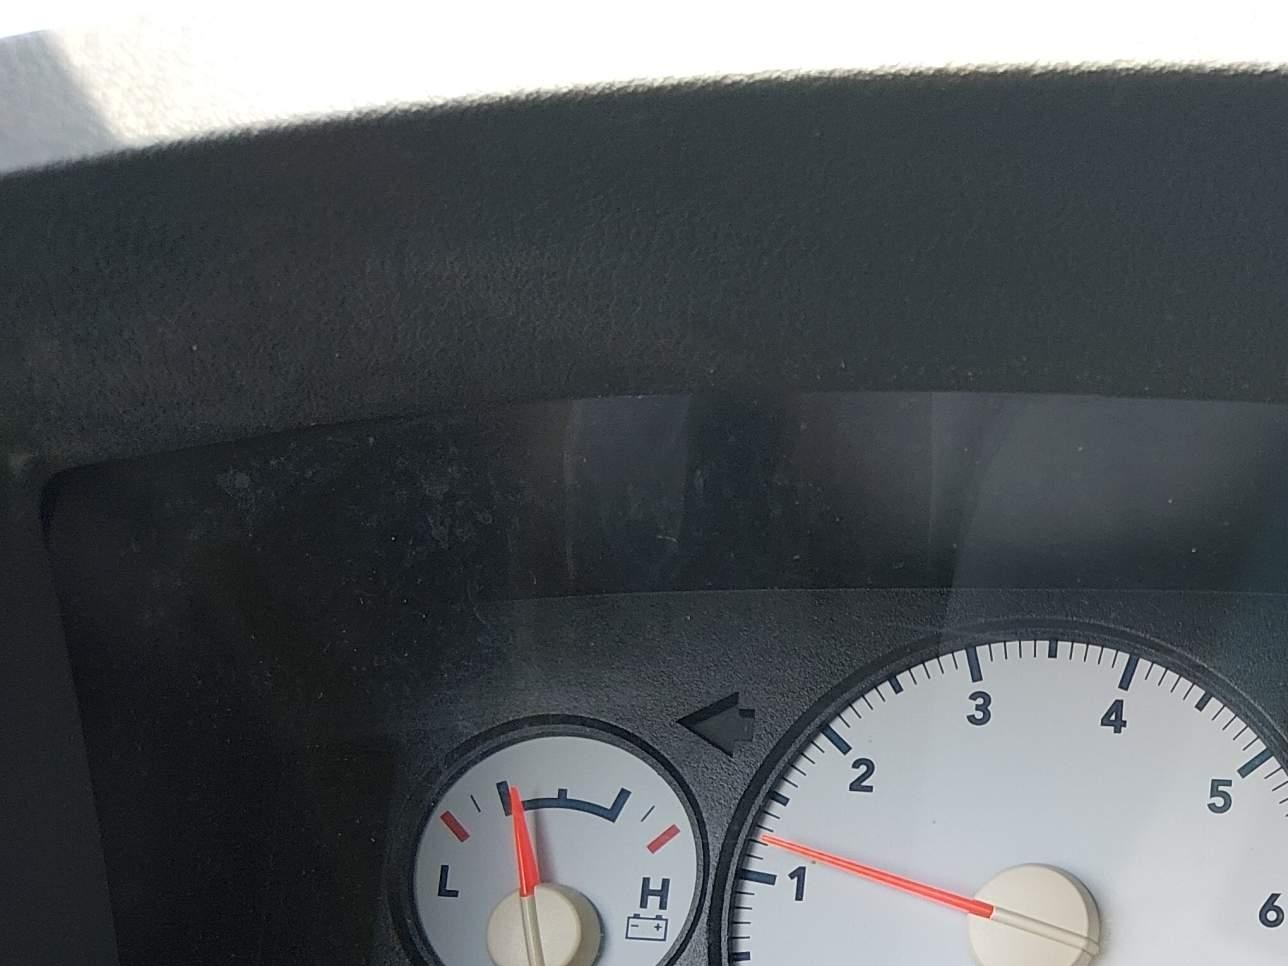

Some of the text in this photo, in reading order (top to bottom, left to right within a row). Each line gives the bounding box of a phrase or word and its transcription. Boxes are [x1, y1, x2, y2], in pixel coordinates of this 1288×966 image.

[966, 690, 992, 726] 3
[1100, 698, 1128, 734] 4
[848, 757, 876, 794] 2
[1207, 778, 1233, 814] 5
[437, 864, 460, 898] L
[639, 876, 671, 911] H
[787, 865, 807, 902] 1
[1258, 892, 1285, 929] 6
